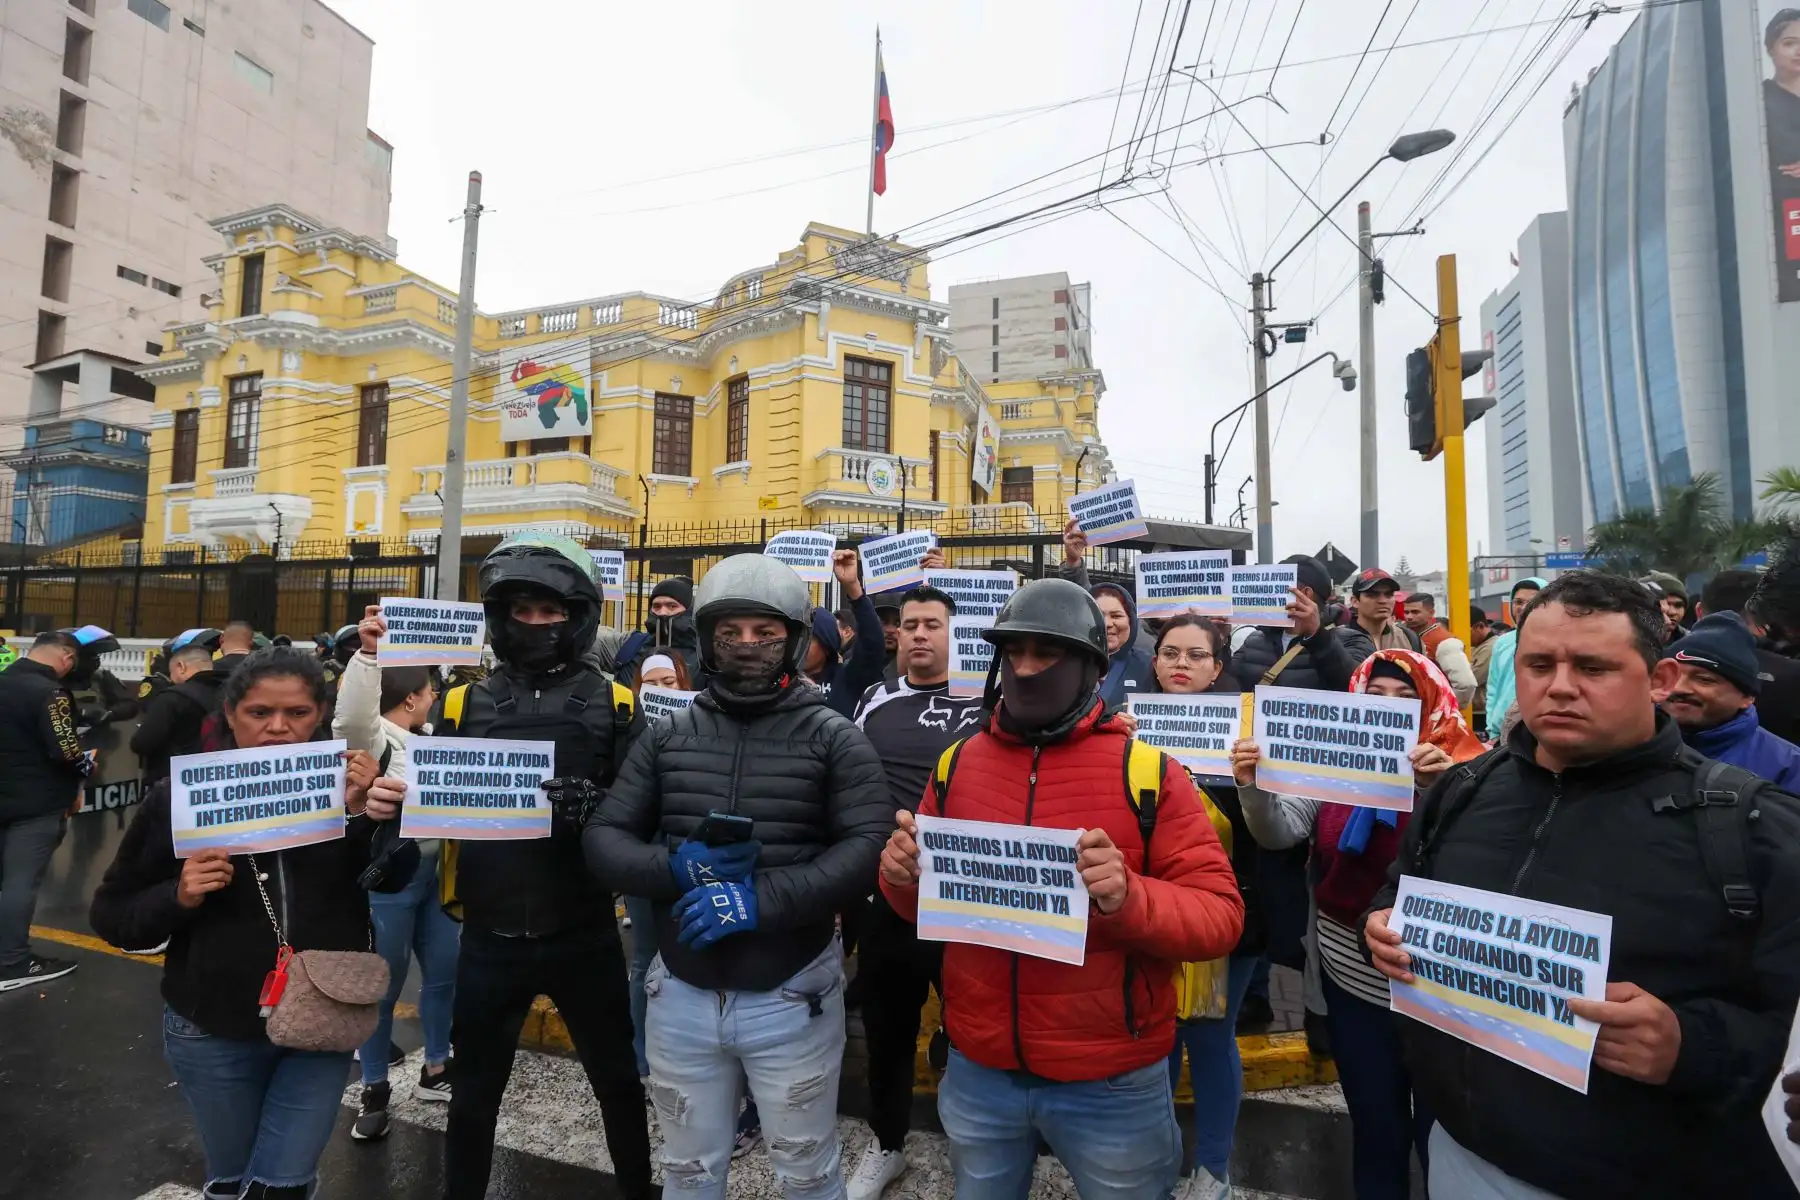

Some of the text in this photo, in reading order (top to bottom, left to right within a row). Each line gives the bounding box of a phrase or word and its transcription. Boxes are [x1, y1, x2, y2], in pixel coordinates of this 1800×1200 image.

[509, 410, 528, 419] TODA
[1071, 487, 1133, 512] QUEREMOS LA AYUDA
[1087, 504, 1118, 519] COMANDO
[1119, 499, 1133, 509] SUR
[1079, 511, 1134, 531] INTERVENCION YA
[811, 538, 833, 547] AYUDA
[864, 536, 929, 558] QUEREMOS LA AYUDA
[778, 547, 813, 556] COMANDO
[869, 559, 880, 568] DEL
[881, 550, 912, 564] COMANDO
[913, 546, 927, 554] SUR
[872, 559, 918, 577] INTERVENCION
[1140, 559, 1228, 572] QUEREMOS LA AYUDA
[928, 578, 1013, 590] QUEREMOS LA AYUDA
[1145, 573, 1224, 584] DEL COMANDO SUR
[1232, 572, 1294, 582] EREMOS LA AYUDA
[1148, 586, 1221, 597] INTERVENCION YA
[1240, 585, 1273, 593] COMANDO
[1275, 585, 1289, 593] SUR
[992, 594, 1008, 603] SUR
[1232, 597, 1286, 606] NTERVENCION YA
[384, 606, 484, 621] QUEREMOS LA AYUDA
[388, 620, 478, 633] DEL COMANDO SUR
[390, 634, 472, 645] INTERVENCION YA
[958, 644, 974, 655] DEL
[644, 692, 687, 708] QUEREMOS
[645, 704, 659, 714] DEL
[1134, 704, 1237, 719] QUEREMOS LA AYUDA
[1262, 700, 1413, 730] QUEREMOS LA AYUDA
[48, 704, 64, 736] ENERGY
[1137, 719, 1230, 734] DEL COMANDO SUR
[1213, 738, 1225, 750] YA
[1267, 722, 1405, 752] DEL COMANDO SUR
[413, 750, 550, 768] QUEREMOS LA AYUDA
[1270, 744, 1398, 774] INTERVENCION YA
[181, 753, 342, 786] QUEREMOS LA AYUDA
[418, 771, 542, 788] DEL COMANDO SUR
[78, 782, 136, 813] LICIA
[190, 774, 335, 806] DEL COMANDO SUR
[420, 792, 536, 808] INTERVENCION YA
[196, 795, 331, 827] INTERVENCION YA
[924, 832, 1078, 864] QUEREMOS LA AYUDA
[933, 856, 1074, 888] DEL COMANDO SUR
[727, 882, 747, 920] ALPINES
[940, 881, 1070, 915] INTERVENCION YA
[1402, 896, 1600, 963] QUEREMOS LA AYUDA
[1402, 923, 1584, 994] DEL COMANDO SUR
[1410, 954, 1574, 1026] INTERVENCION YA
